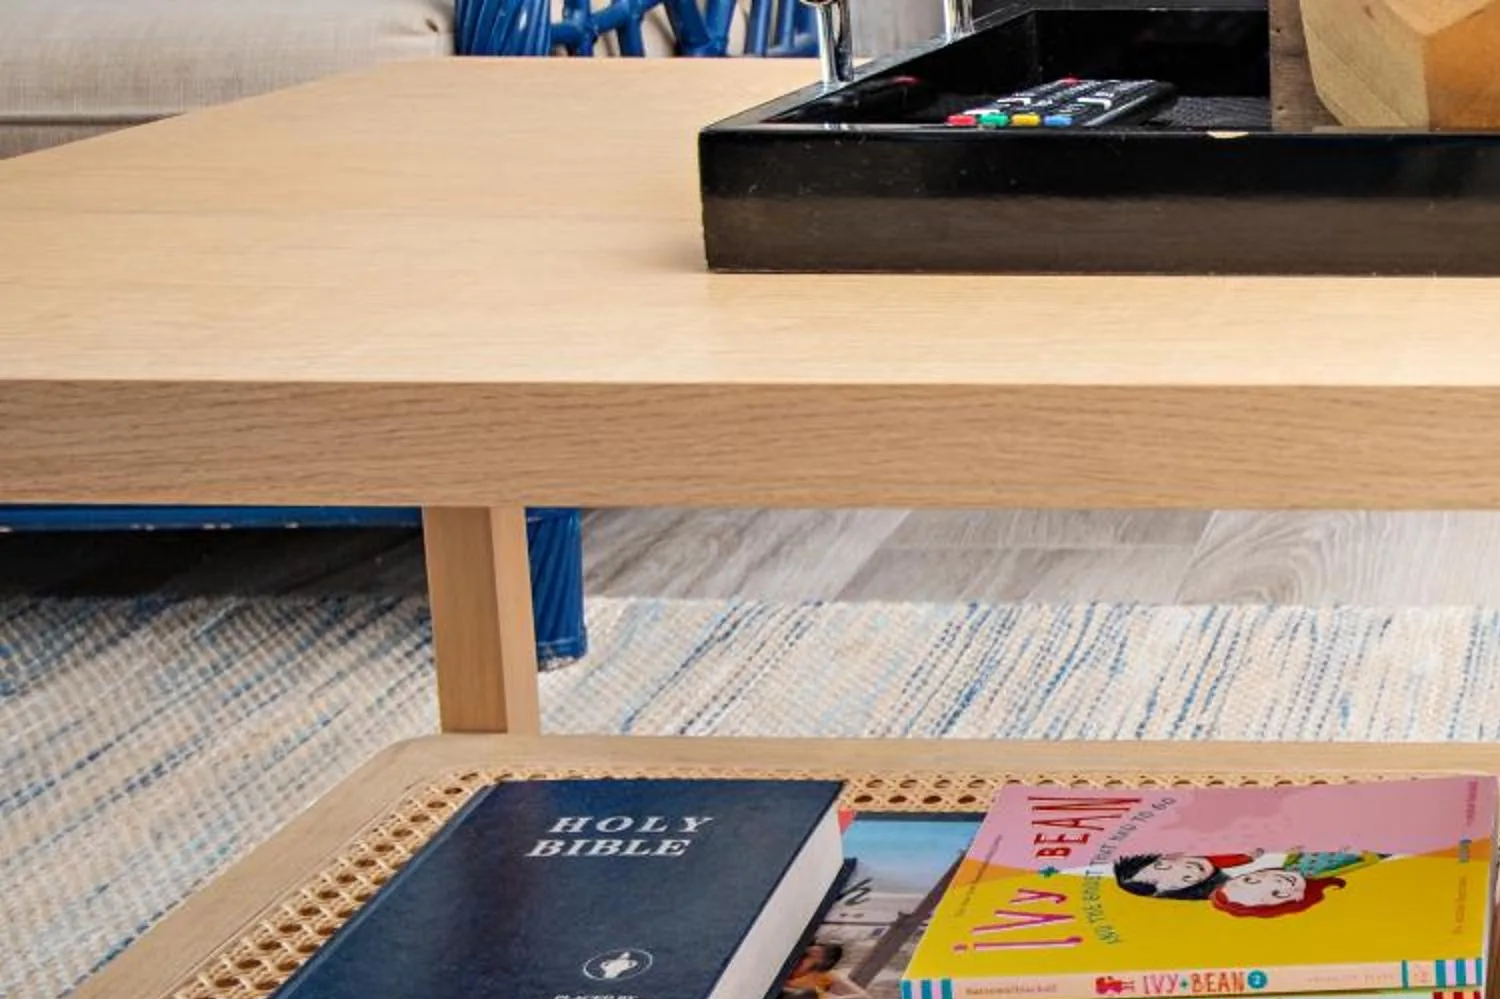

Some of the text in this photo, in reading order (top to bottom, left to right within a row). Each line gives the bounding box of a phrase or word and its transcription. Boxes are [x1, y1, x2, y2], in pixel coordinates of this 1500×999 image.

[547, 815, 714, 833] HOLY
[1026, 796, 1143, 858] BEAN
[524, 838, 692, 857] BIBLE
